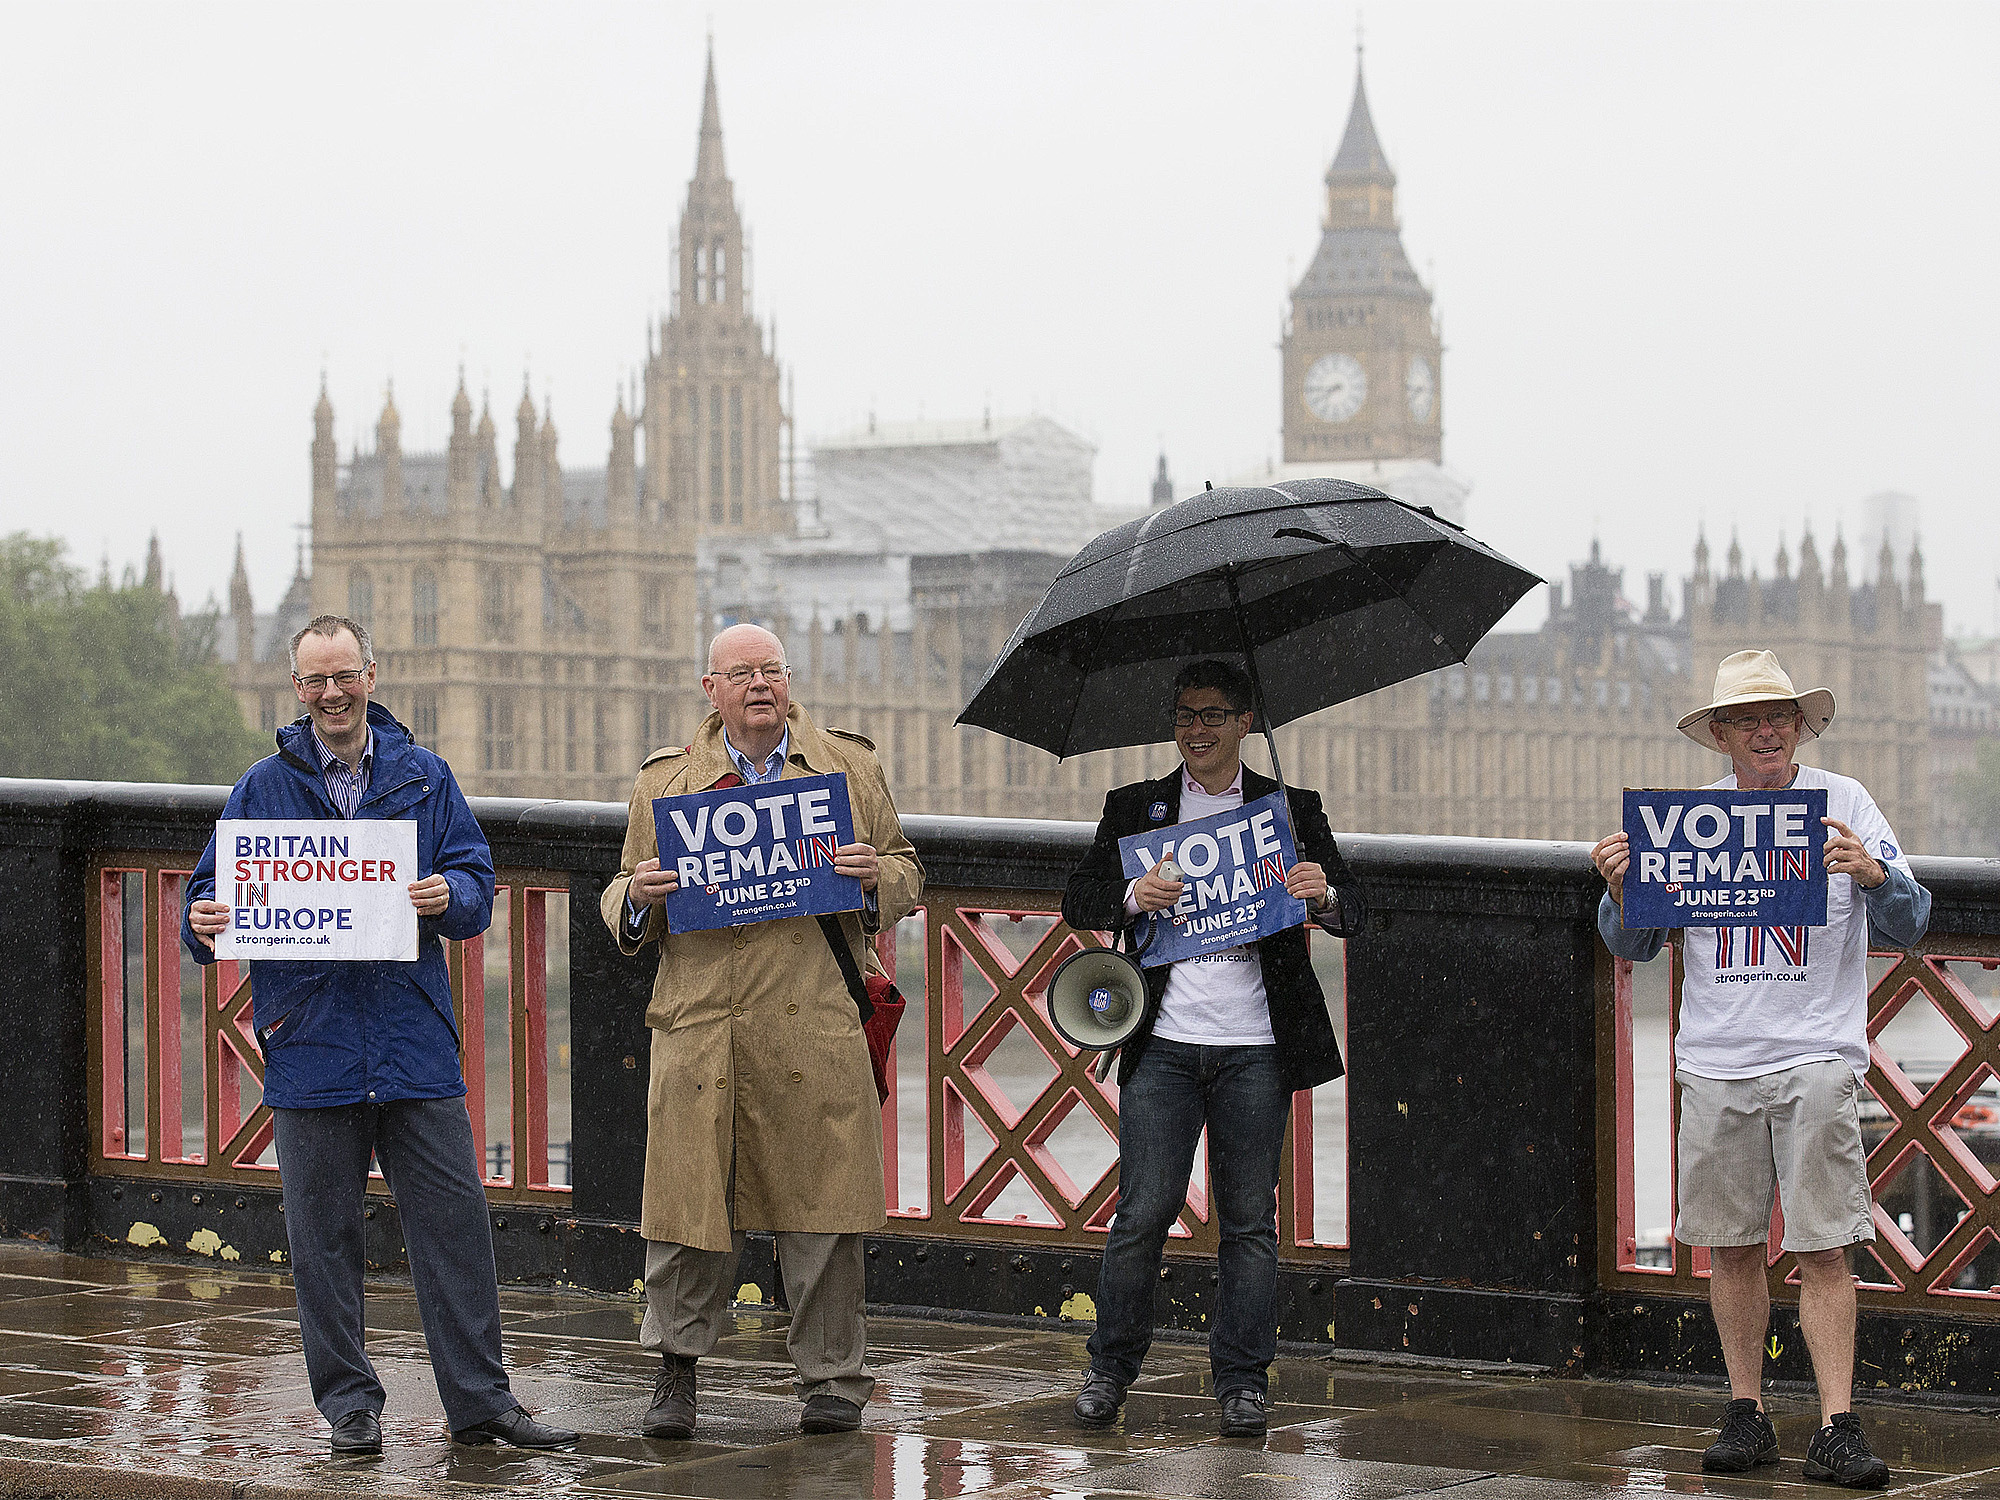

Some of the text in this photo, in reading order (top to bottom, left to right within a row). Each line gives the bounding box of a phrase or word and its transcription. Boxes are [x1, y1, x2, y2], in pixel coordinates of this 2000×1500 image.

[669, 788, 837, 853] VOTE
[1638, 804, 1809, 849] VOTE
[235, 836, 349, 857] BRITAIN
[1134, 809, 1281, 878] VOTE
[234, 860, 396, 881] STRONGER
[677, 835, 839, 888] REMAIN
[1640, 850, 1809, 883] REMAIN
[235, 883, 269, 906] IN
[706, 878, 811, 907] ON JUNE 23RD
[1147, 853, 1287, 920] EMAIN
[1665, 883, 1776, 907] ON JUNE 23RD
[235, 908, 352, 930] EUROPE
[732, 900, 797, 916] strongerin.co.uk
[1172, 899, 1266, 937] ON JUNE 23RD
[1691, 910, 1758, 919] strongerin.co.uk
[235, 935, 331, 947] strongerin.co.uk
[1200, 924, 1259, 946] strongerin.co.uk
[1715, 926, 1810, 969] IN
[1714, 970, 1808, 984] strongerin.co.uk
